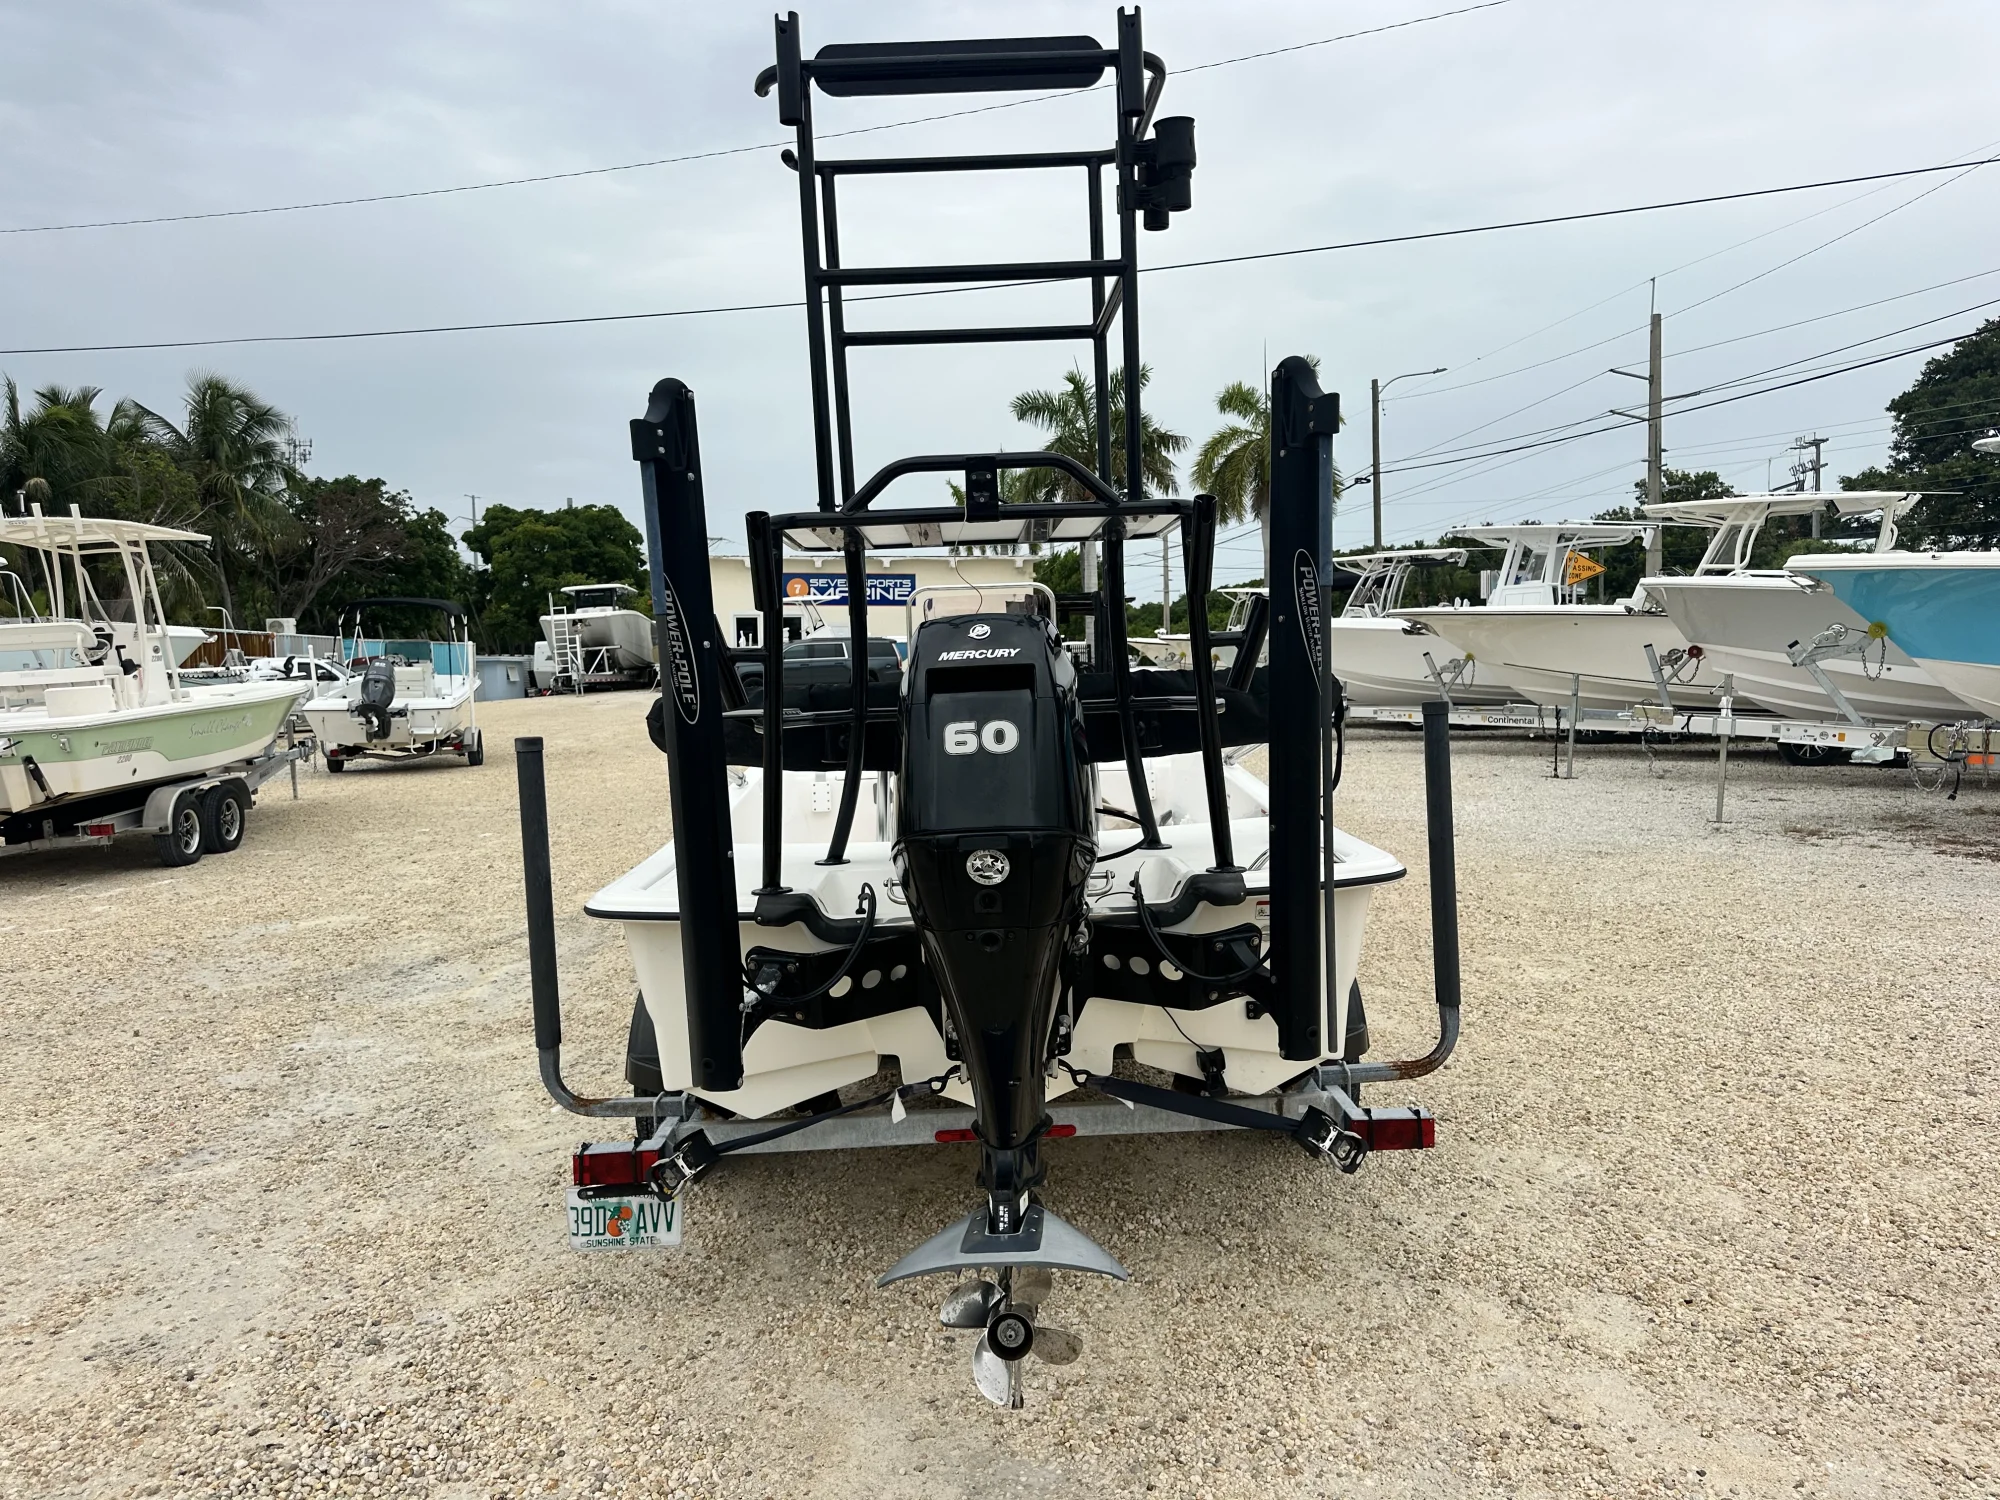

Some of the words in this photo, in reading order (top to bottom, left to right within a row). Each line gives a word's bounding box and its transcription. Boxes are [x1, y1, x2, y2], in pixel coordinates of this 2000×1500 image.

[794, 584, 801, 594] 7
[809, 579, 848, 587] SEVE
[1305, 616, 1313, 637] WATER
[938, 648, 1021, 661] MERCURY
[1487, 716, 1535, 725] Continental
[943, 719, 1020, 756] 60
[570, 1206, 606, 1236] 39D
[635, 1202, 675, 1234] AVV
[586, 1238, 626, 1248] SUNSHINE
[629, 1235, 656, 1246] STATE
